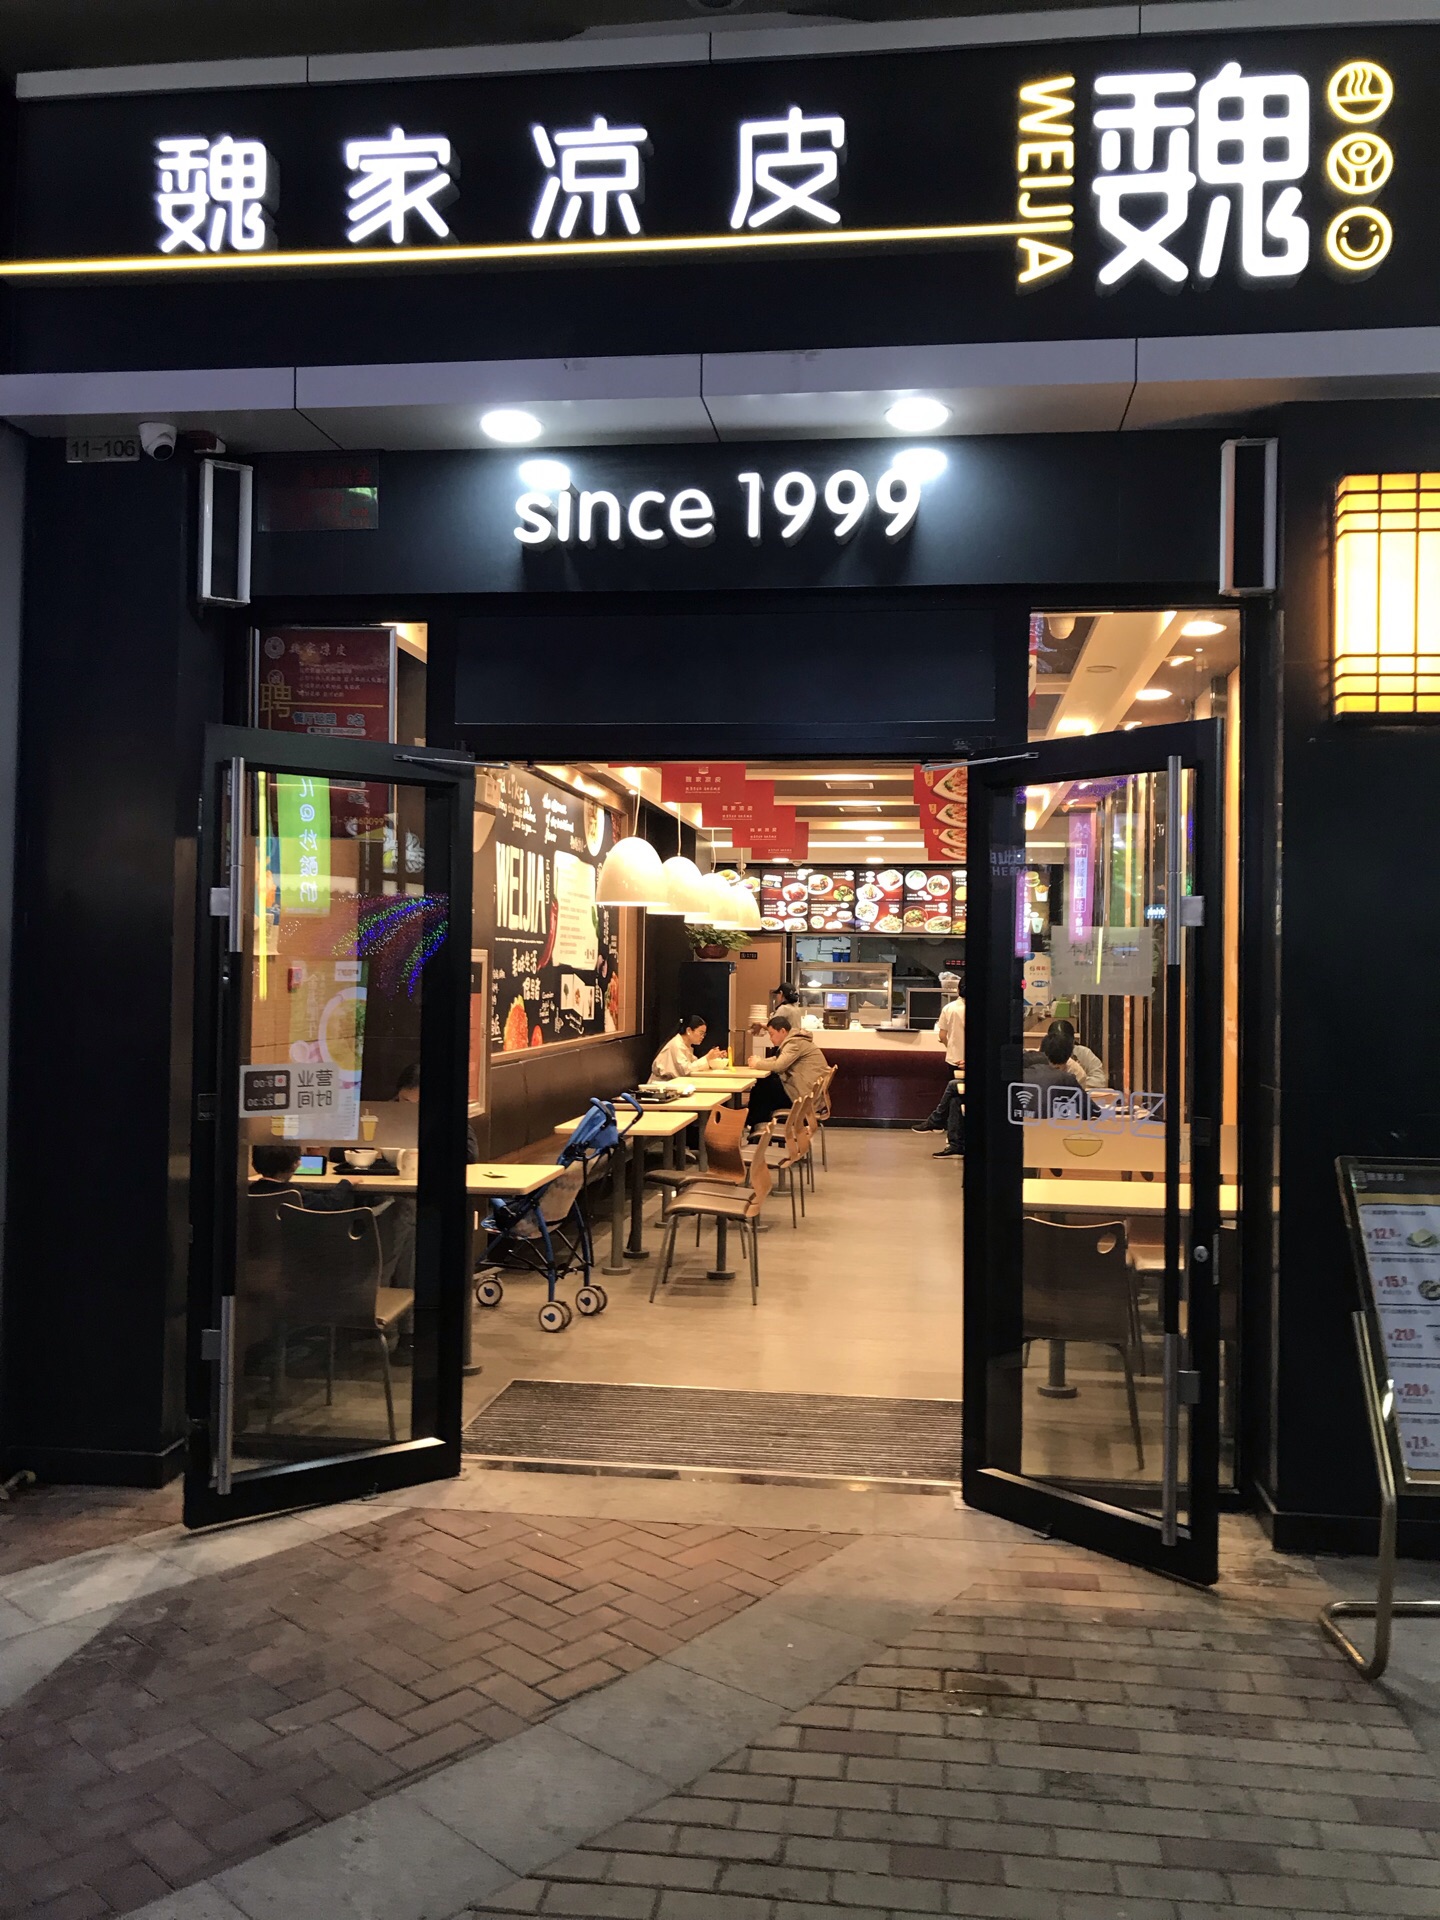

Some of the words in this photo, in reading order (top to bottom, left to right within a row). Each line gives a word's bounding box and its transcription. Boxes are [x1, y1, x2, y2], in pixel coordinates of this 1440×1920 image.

[154, 106, 847, 254] 魏家凉皮
[1017, 73, 1075, 285] WEIJIA
[1091, 60, 1311, 286] 魏
[71, 440, 136, 458] 11-106
[513, 478, 715, 545] since
[737, 469, 923, 540] 1999
